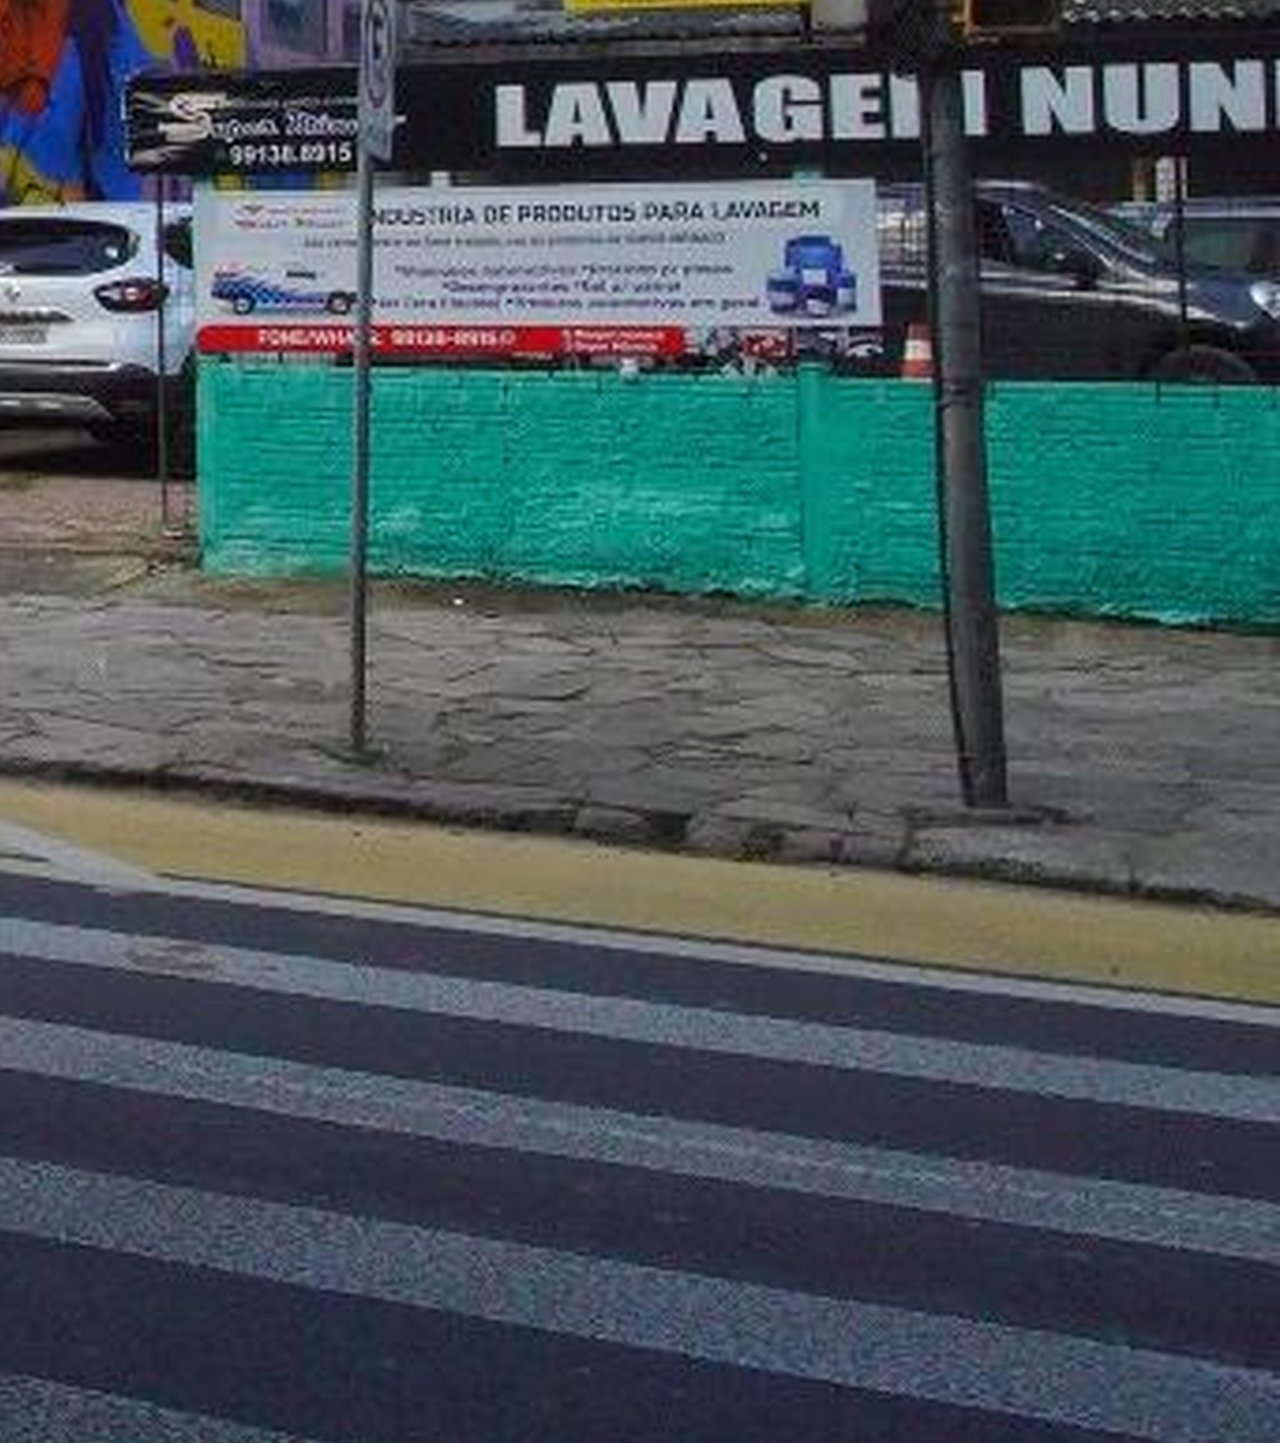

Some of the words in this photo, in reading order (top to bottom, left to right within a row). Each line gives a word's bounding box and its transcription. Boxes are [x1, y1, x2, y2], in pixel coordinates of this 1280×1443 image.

[1018, 58, 1280, 137] NUN
[371, 205, 476, 226] NDUSTRIA
[483, 204, 512, 225] DE
[517, 203, 637, 223] PRODUTOS
[644, 201, 704, 222] PARA
[712, 200, 821, 220] LAVAGEM
